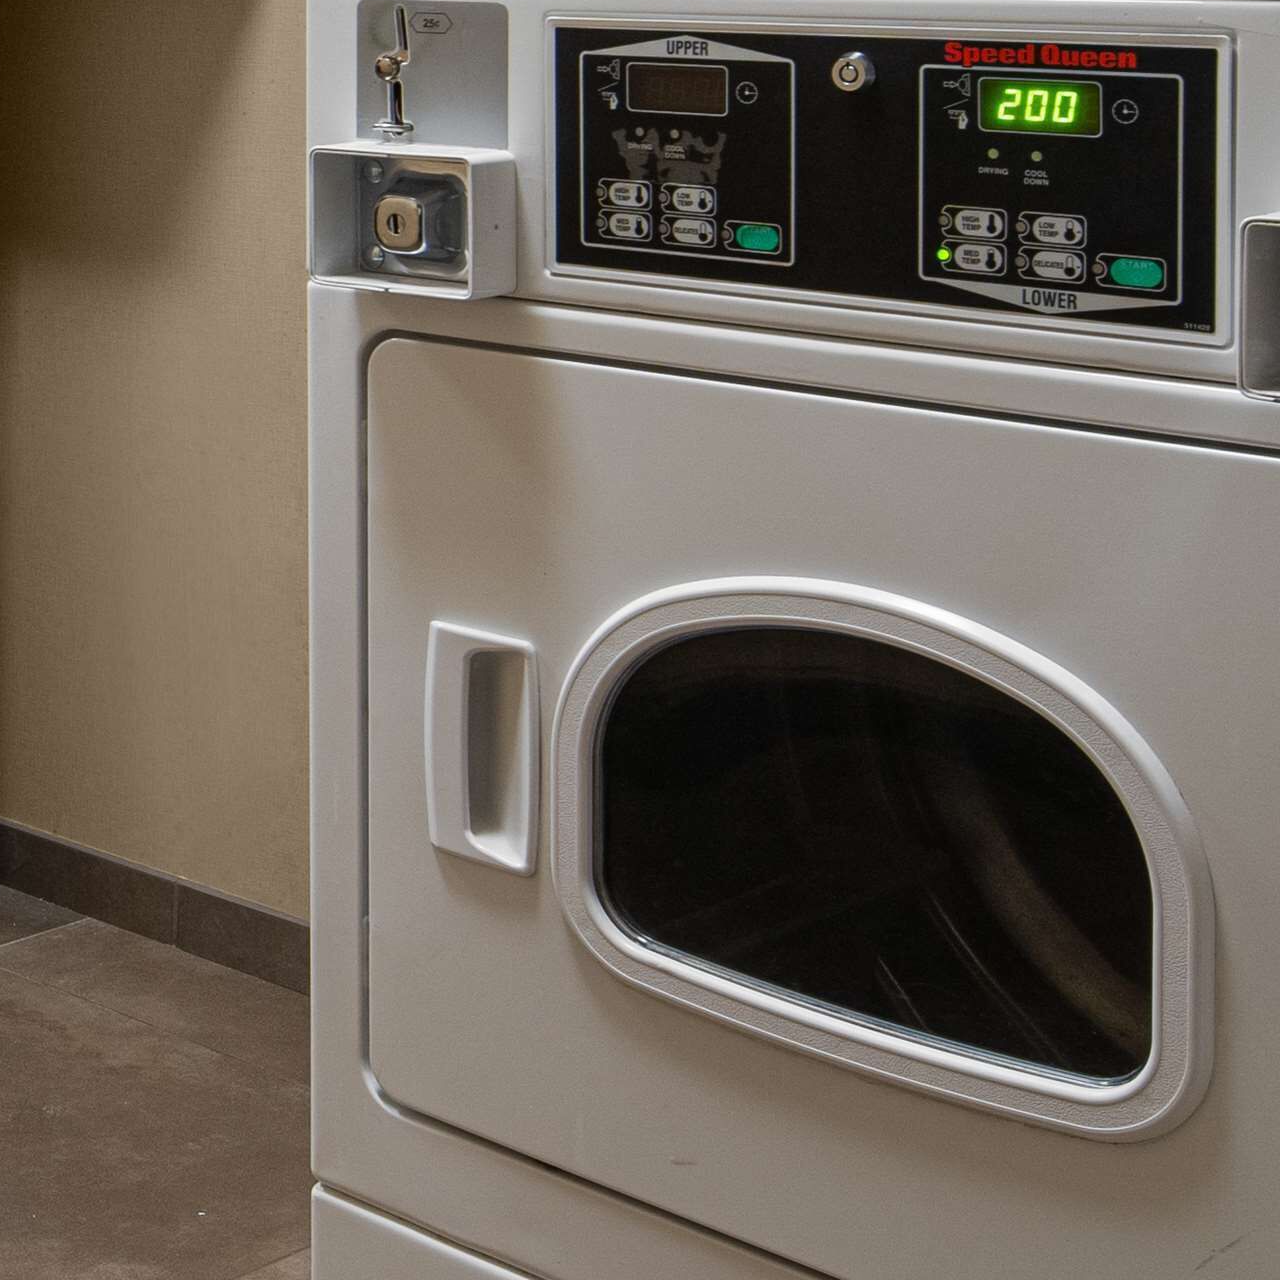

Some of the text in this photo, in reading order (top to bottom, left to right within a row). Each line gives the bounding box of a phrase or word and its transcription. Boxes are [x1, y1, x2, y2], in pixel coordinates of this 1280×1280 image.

[666, 39, 709, 56] UPPER
[943, 40, 1137, 69] Speed Queen
[996, 87, 1079, 124] 200
[665, 144, 685, 153] COOL
[664, 152, 686, 160] DOWN
[977, 165, 1009, 176] DRYING
[1024, 168, 1048, 178] COOL
[1023, 177, 1050, 187] DOWN
[614, 194, 631, 202] TEMP
[676, 192, 691, 200] LOW
[676, 199, 694, 207] TEMP
[961, 214, 981, 224] HIGH
[615, 224, 631, 232] TEMP
[961, 222, 982, 232] TEMP
[1038, 221, 1057, 230] LOW
[1038, 228, 1059, 238] TEMP
[963, 249, 980, 258] MED
[961, 256, 982, 266] TEMP
[1033, 260, 1065, 270] DELICATES
[1022, 288, 1078, 310] LOWER
